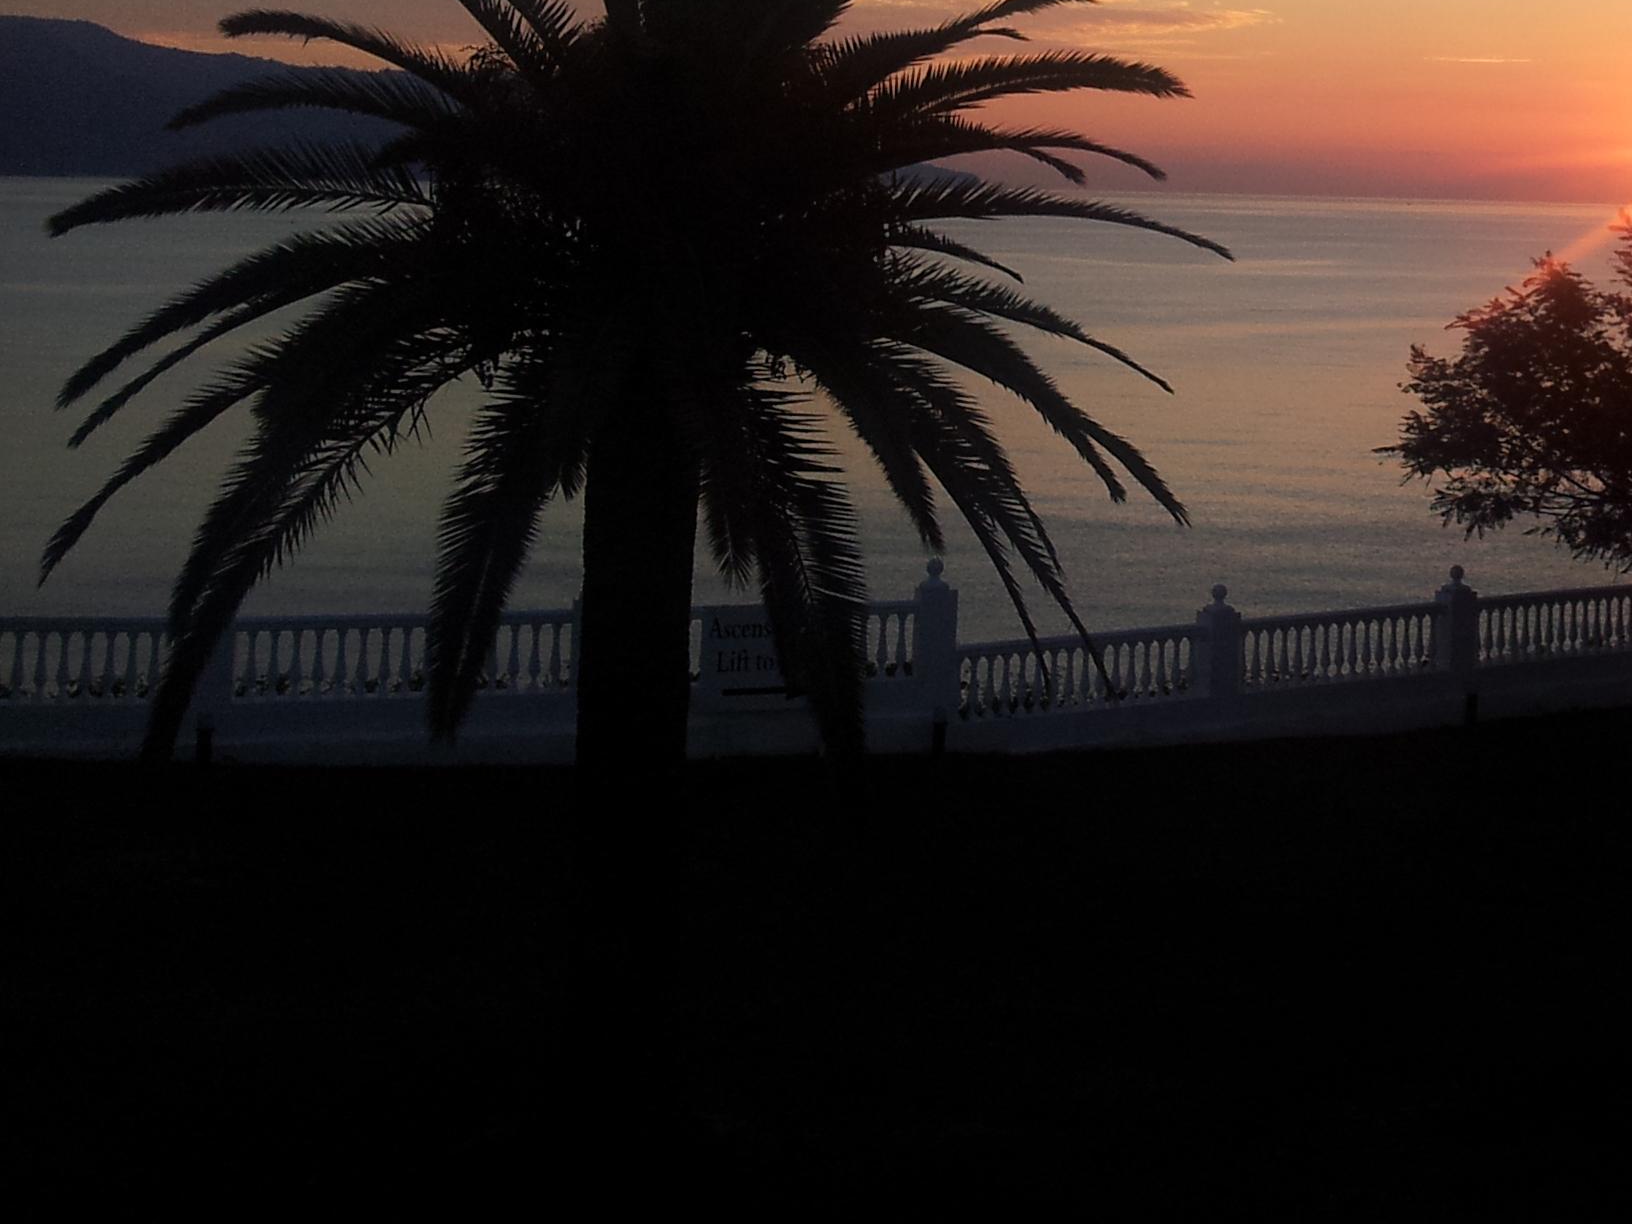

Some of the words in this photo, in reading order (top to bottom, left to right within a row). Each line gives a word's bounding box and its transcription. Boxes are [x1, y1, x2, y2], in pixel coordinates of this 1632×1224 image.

[710, 617, 773, 639] Ascens
[716, 649, 750, 672] Lift
[755, 654, 775, 671] to
